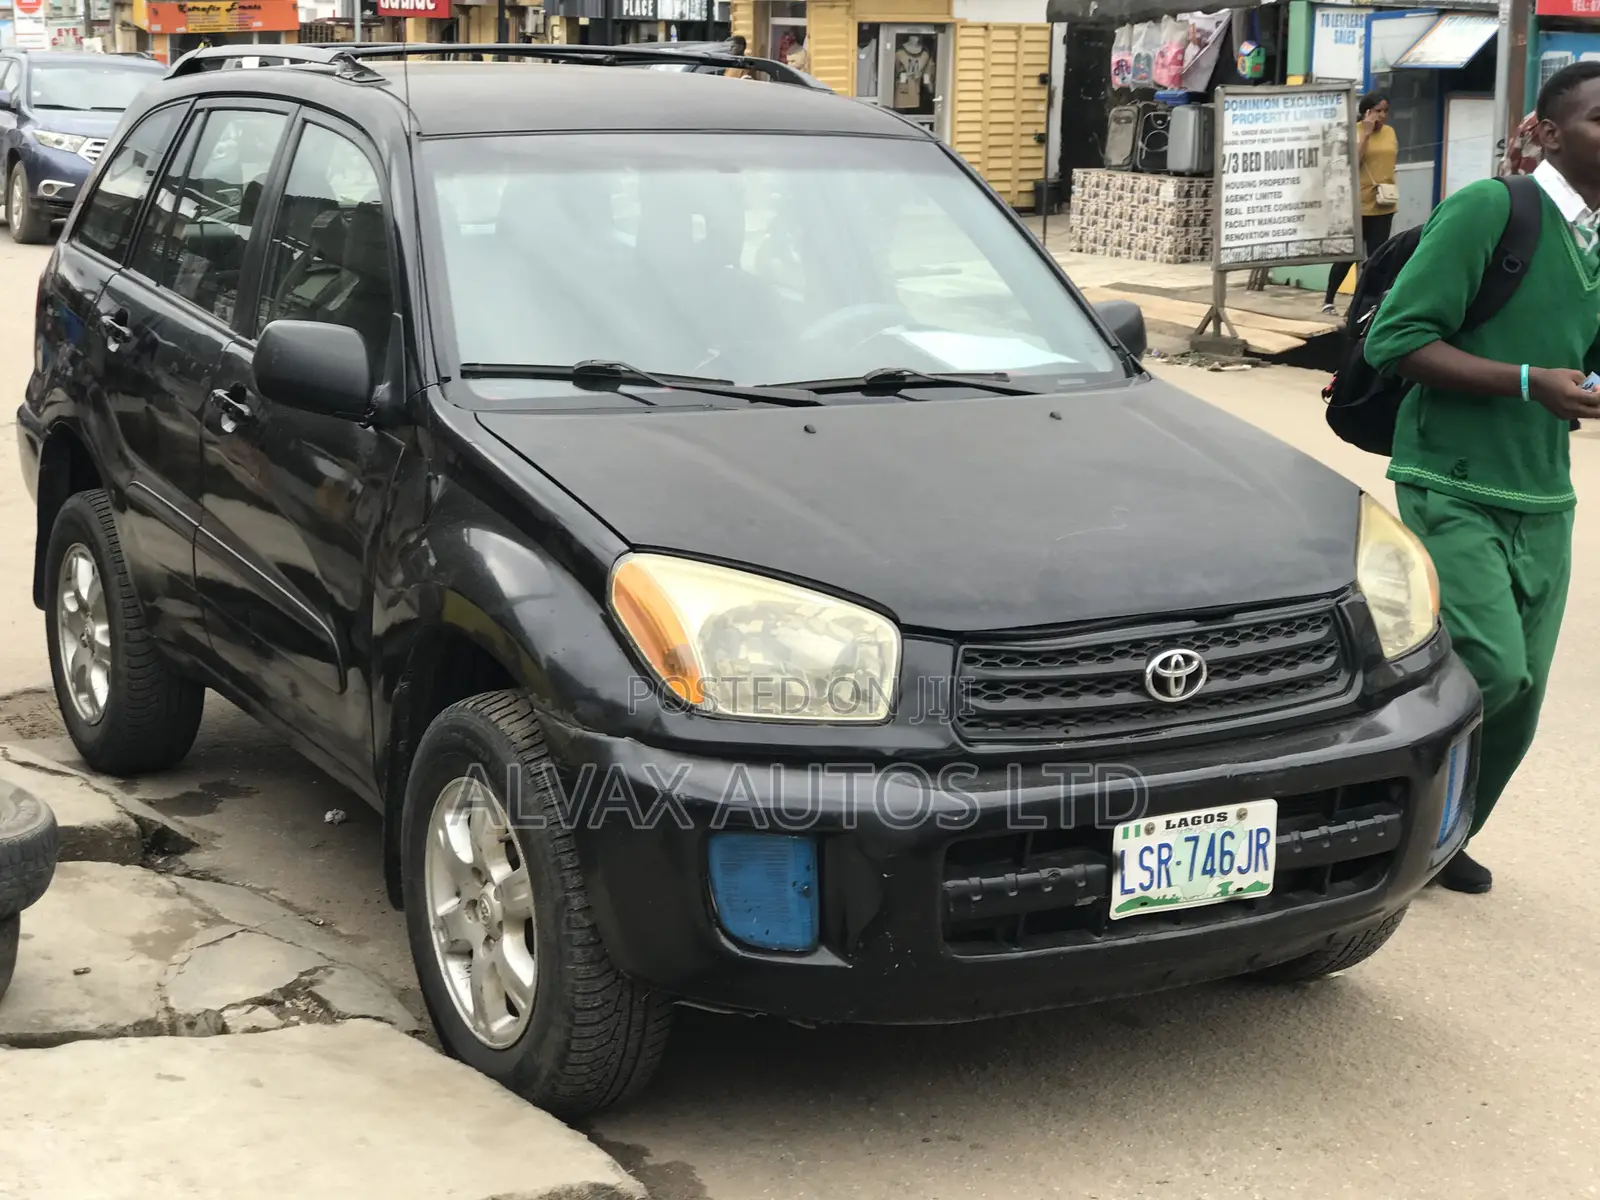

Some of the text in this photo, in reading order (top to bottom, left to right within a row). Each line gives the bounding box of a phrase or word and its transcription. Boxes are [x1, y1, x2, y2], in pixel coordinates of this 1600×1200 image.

[622, 0, 653, 16] PLACE
[57, 28, 78, 37] EYE
[1224, 93, 1343, 112] DOMINION EXCLUSIVE
[1232, 107, 1337, 125] PROPERTY LIMITED
[1242, 152, 1261, 173] BED
[1264, 149, 1295, 172] ROOM
[1297, 147, 1319, 169] FLAT
[1225, 176, 1301, 190] HOUSING PROPERTIES
[1225, 191, 1282, 204] AGENCY LIMITED
[1225, 200, 1322, 216] REAL ESTATE CONSULTANTS
[1225, 214, 1306, 229] FACILITY MANAGEMENT
[1225, 228, 1297, 241] RENOVATION DESIGN
[1165, 811, 1228, 830] LAGOS
